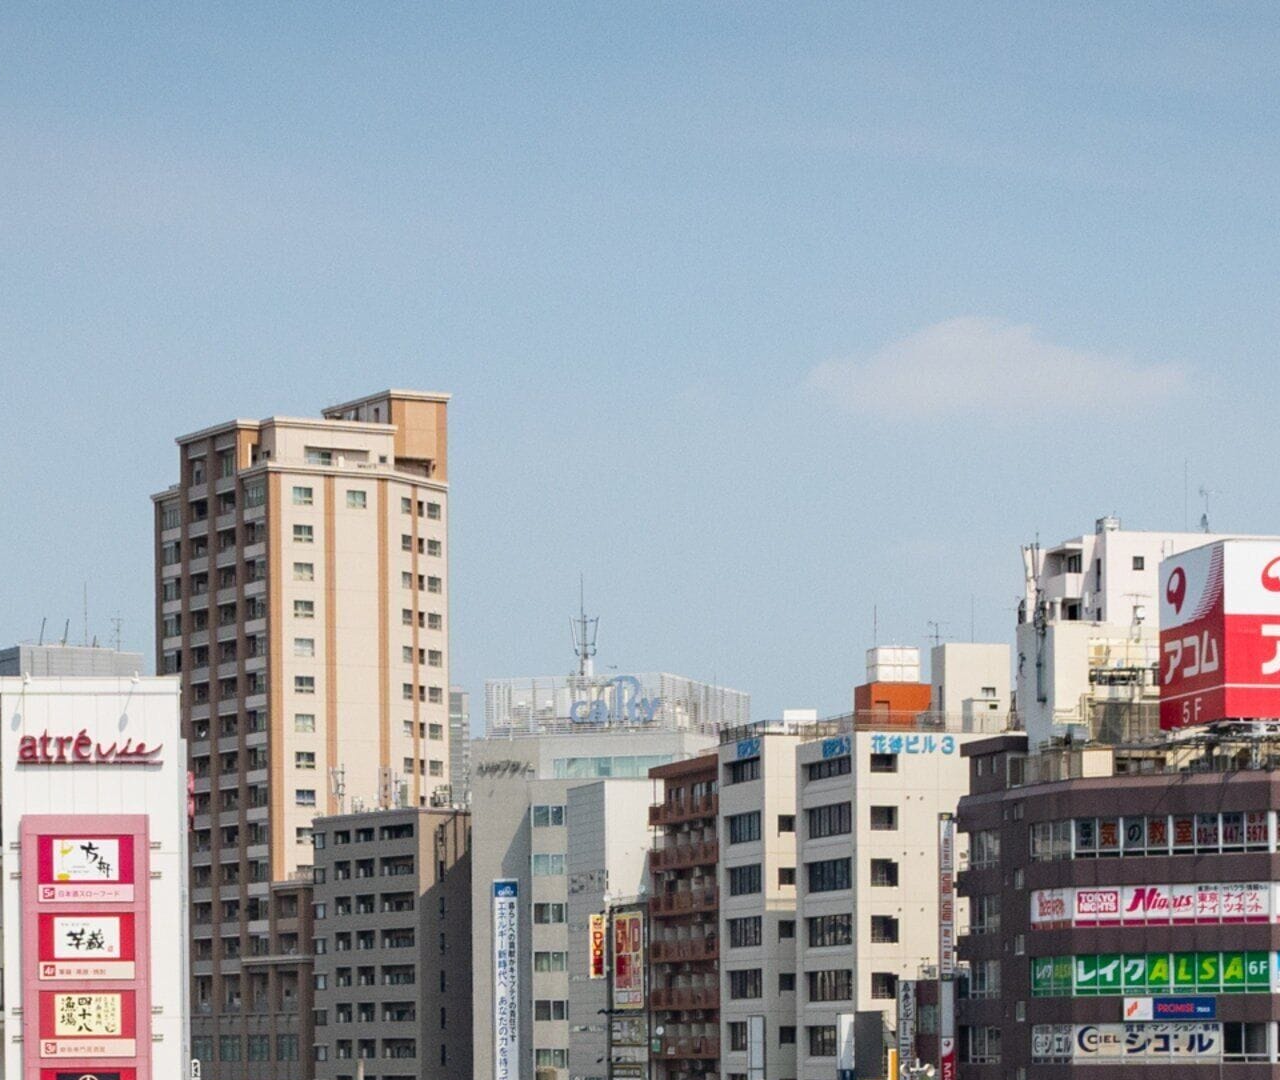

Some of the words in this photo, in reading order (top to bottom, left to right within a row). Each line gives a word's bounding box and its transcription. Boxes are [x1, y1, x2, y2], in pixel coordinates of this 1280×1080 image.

[1165, 630, 1219, 685] アコム
[18, 729, 92, 761] atré
[1080, 893, 1116, 902] TOKYO
[1080, 901, 1116, 911] NIGHTS
[1077, 959, 1145, 983] レイク
[1149, 956, 1245, 980] ALSA
[1249, 960, 1268, 976] 6F
[1157, 1003, 1195, 1013] PROMISE
[1087, 1033, 1121, 1045] CIEL
